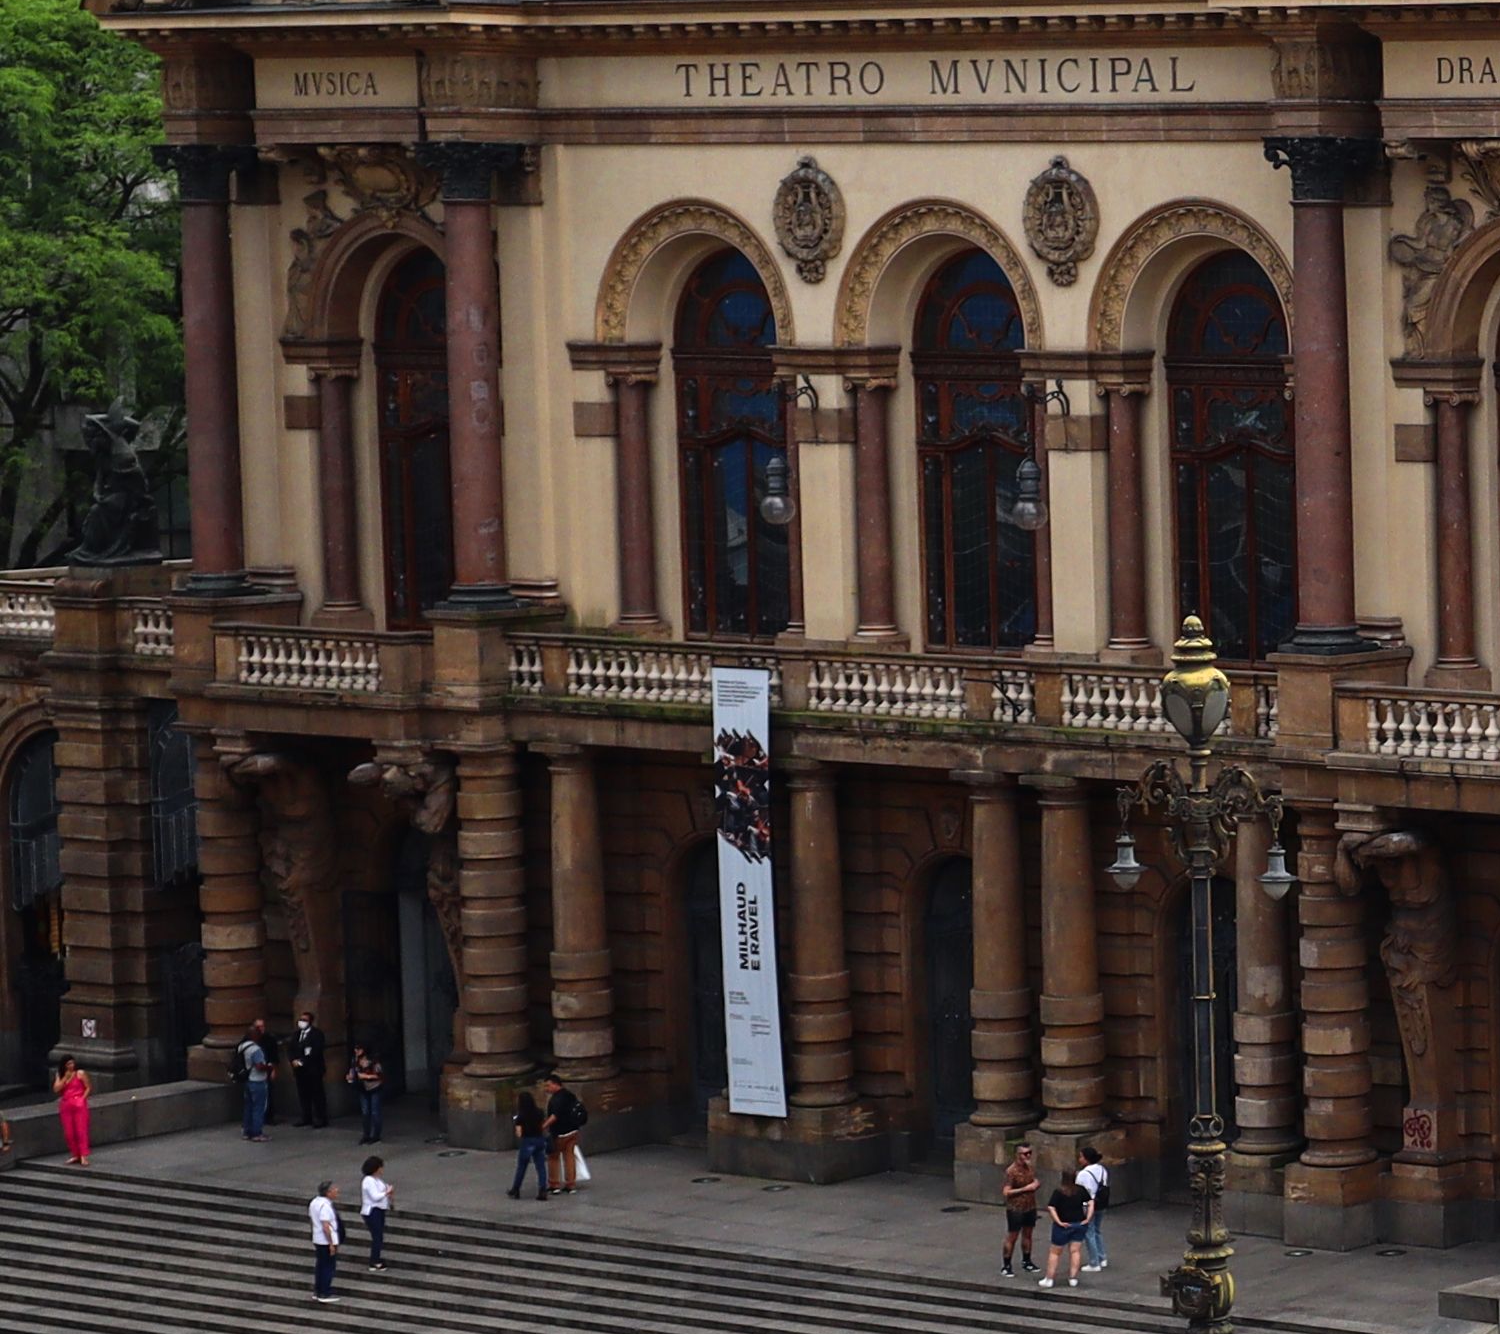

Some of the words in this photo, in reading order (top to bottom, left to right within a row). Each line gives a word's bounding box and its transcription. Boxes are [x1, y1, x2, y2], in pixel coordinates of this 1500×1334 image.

[293, 71, 378, 97] MVSICA
[675, 60, 885, 97] THEATRO
[928, 57, 1196, 95] MVNICIPAL
[736, 881, 749, 971] MILHAUD
[748, 894, 760, 956] RAVEL
[751, 959, 761, 972] E
